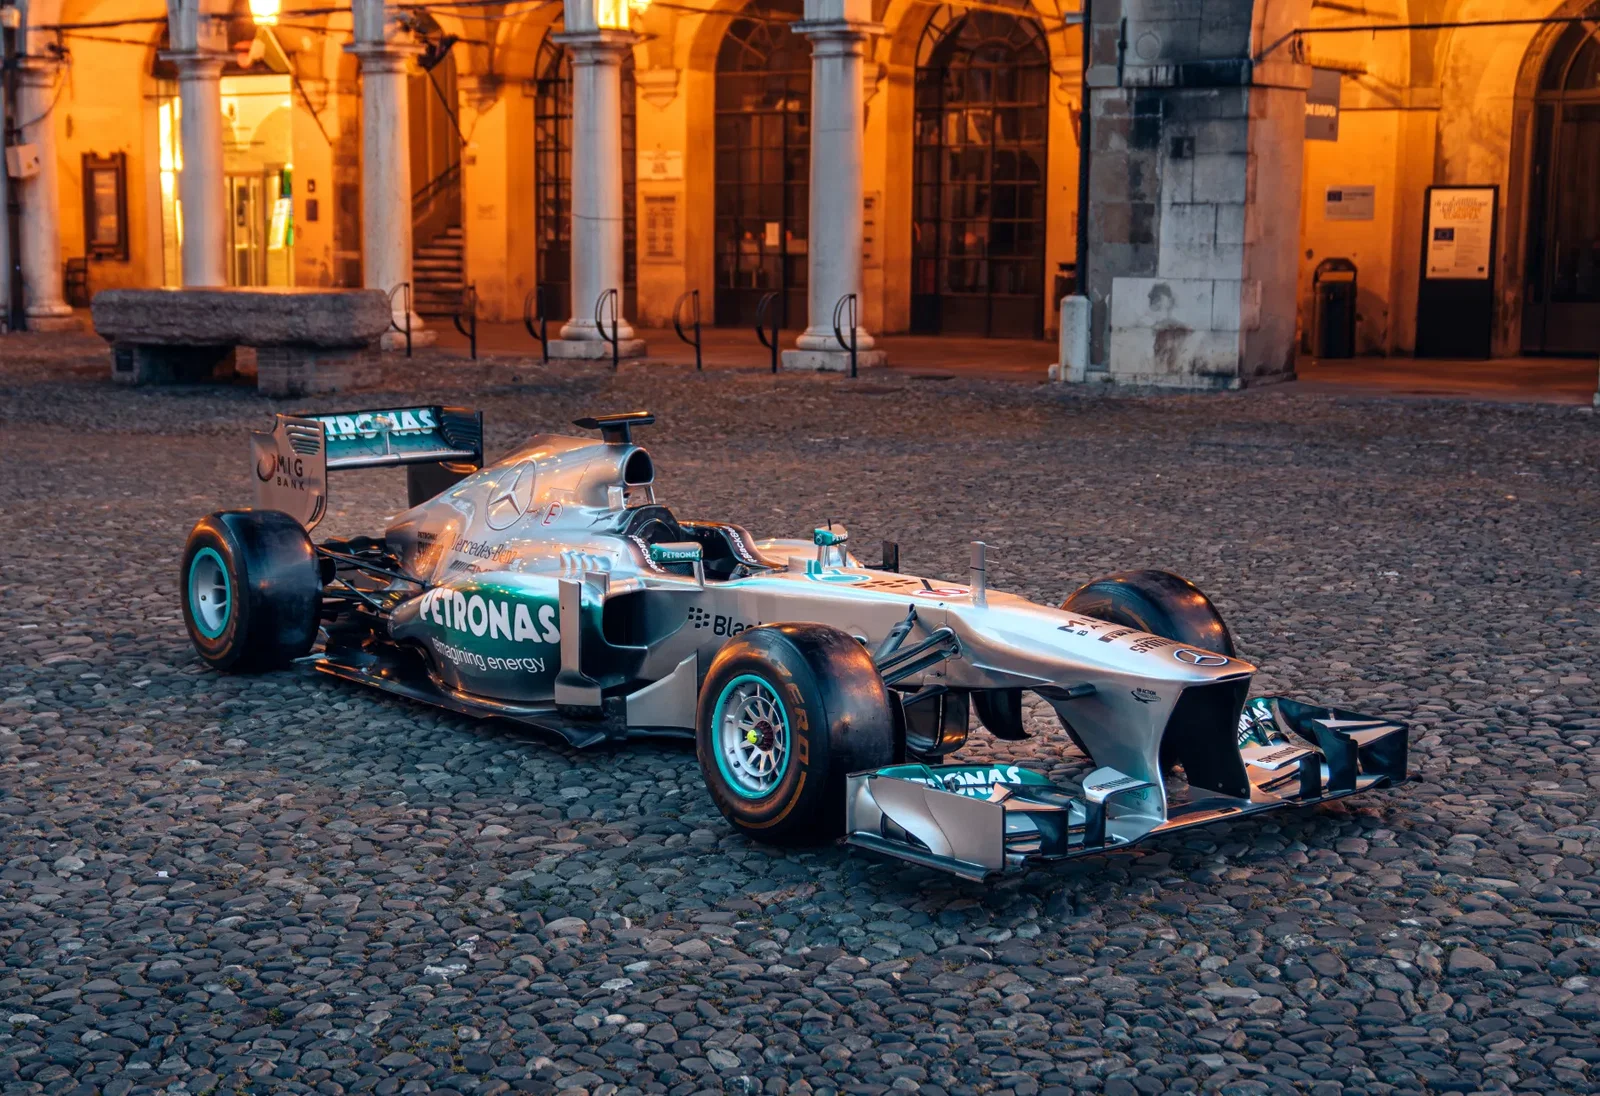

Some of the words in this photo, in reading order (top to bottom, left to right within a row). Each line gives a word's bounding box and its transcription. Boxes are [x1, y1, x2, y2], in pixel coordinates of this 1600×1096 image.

[276, 454, 304, 478] MIG
[277, 476, 305, 491] BANK
[451, 532, 518, 565] Mercedes-Benz
[662, 550, 700, 559] PETRONAS
[419, 587, 561, 645] PETRONAS
[713, 614, 762, 638] Bla
[431, 635, 487, 672] reimagining
[487, 656, 546, 674] energy
